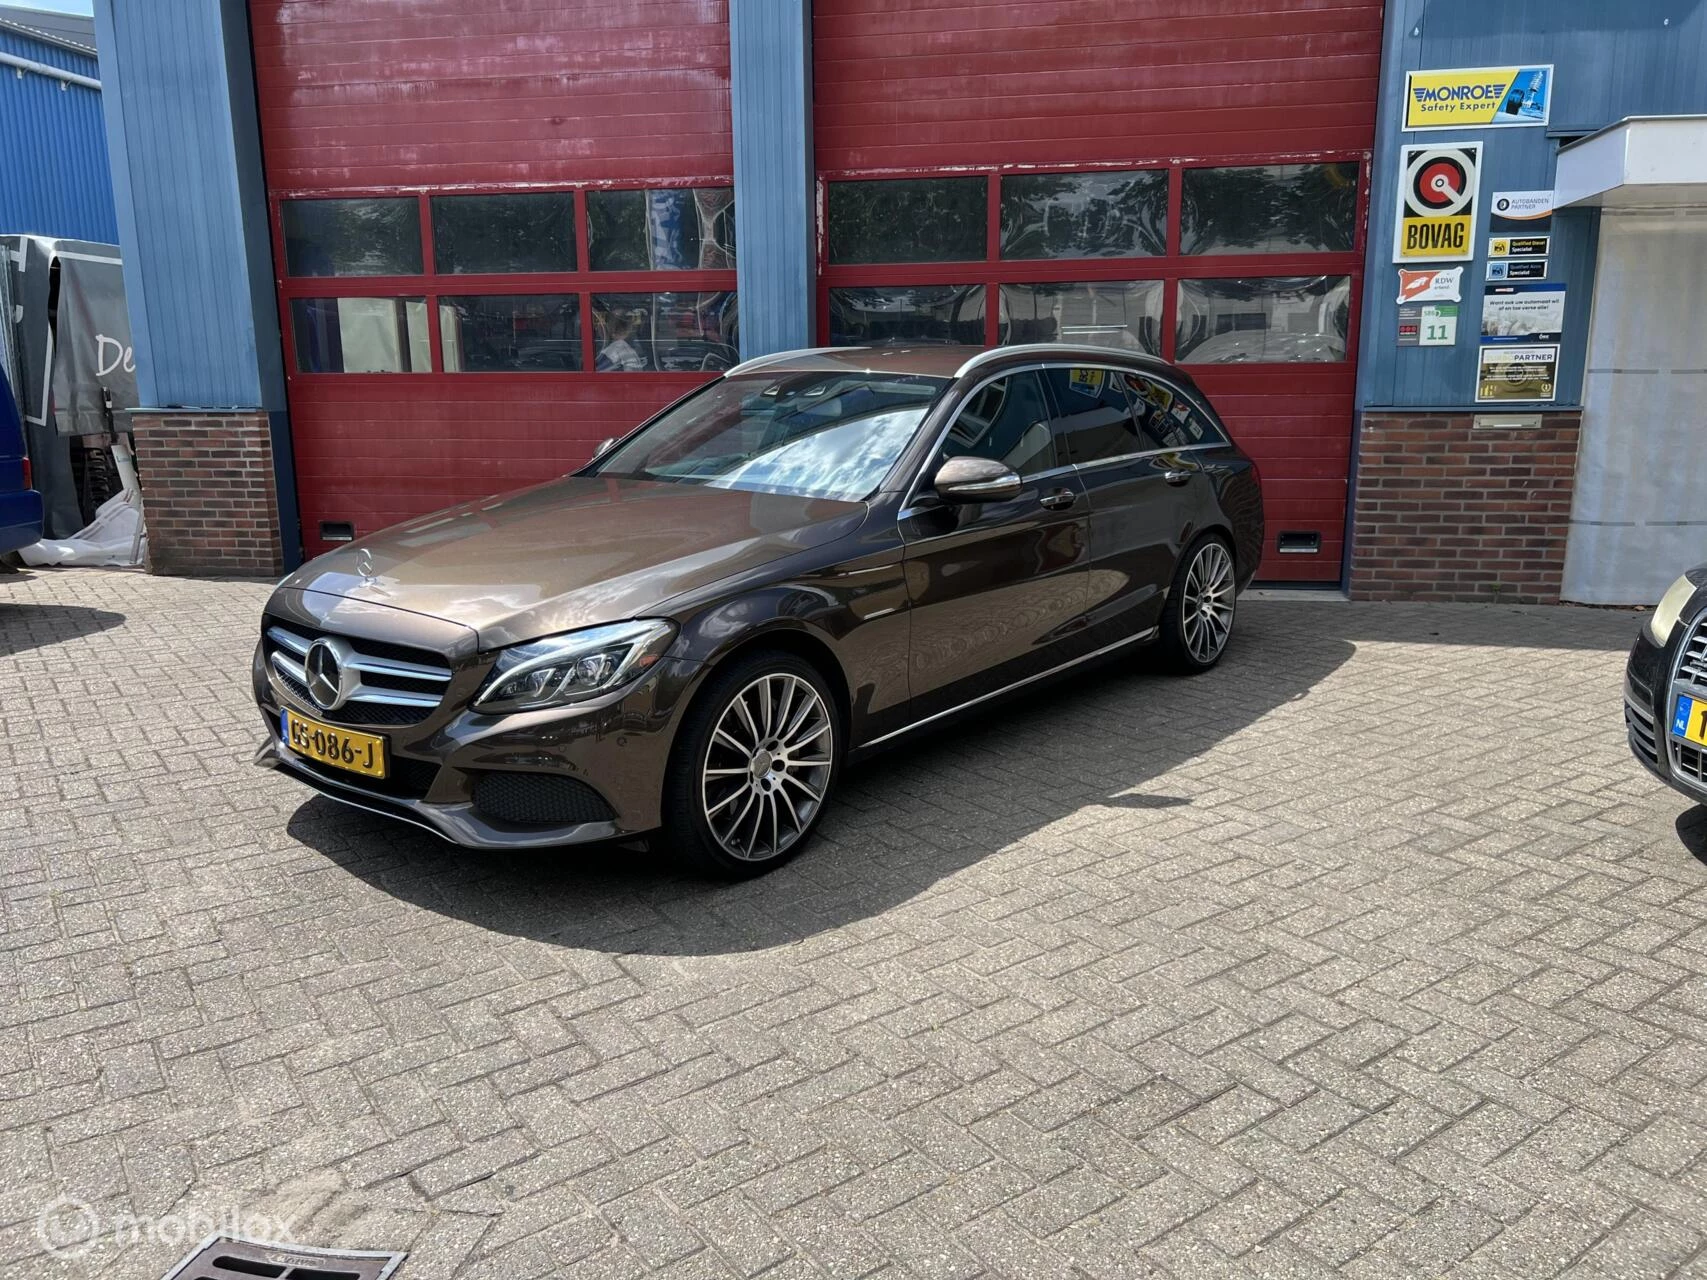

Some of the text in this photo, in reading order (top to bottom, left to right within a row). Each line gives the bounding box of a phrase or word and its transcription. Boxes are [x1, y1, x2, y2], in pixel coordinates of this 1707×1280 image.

[1423, 85, 1493, 102] MONROE
[1420, 102, 1496, 112] Safety Expert
[1406, 222, 1465, 250] BOVAG
[1427, 324, 1448, 340] 11
[1514, 353, 1553, 361] PARTNER
[1675, 718, 1686, 731] NL
[291, 719, 374, 769] GS-086-J
